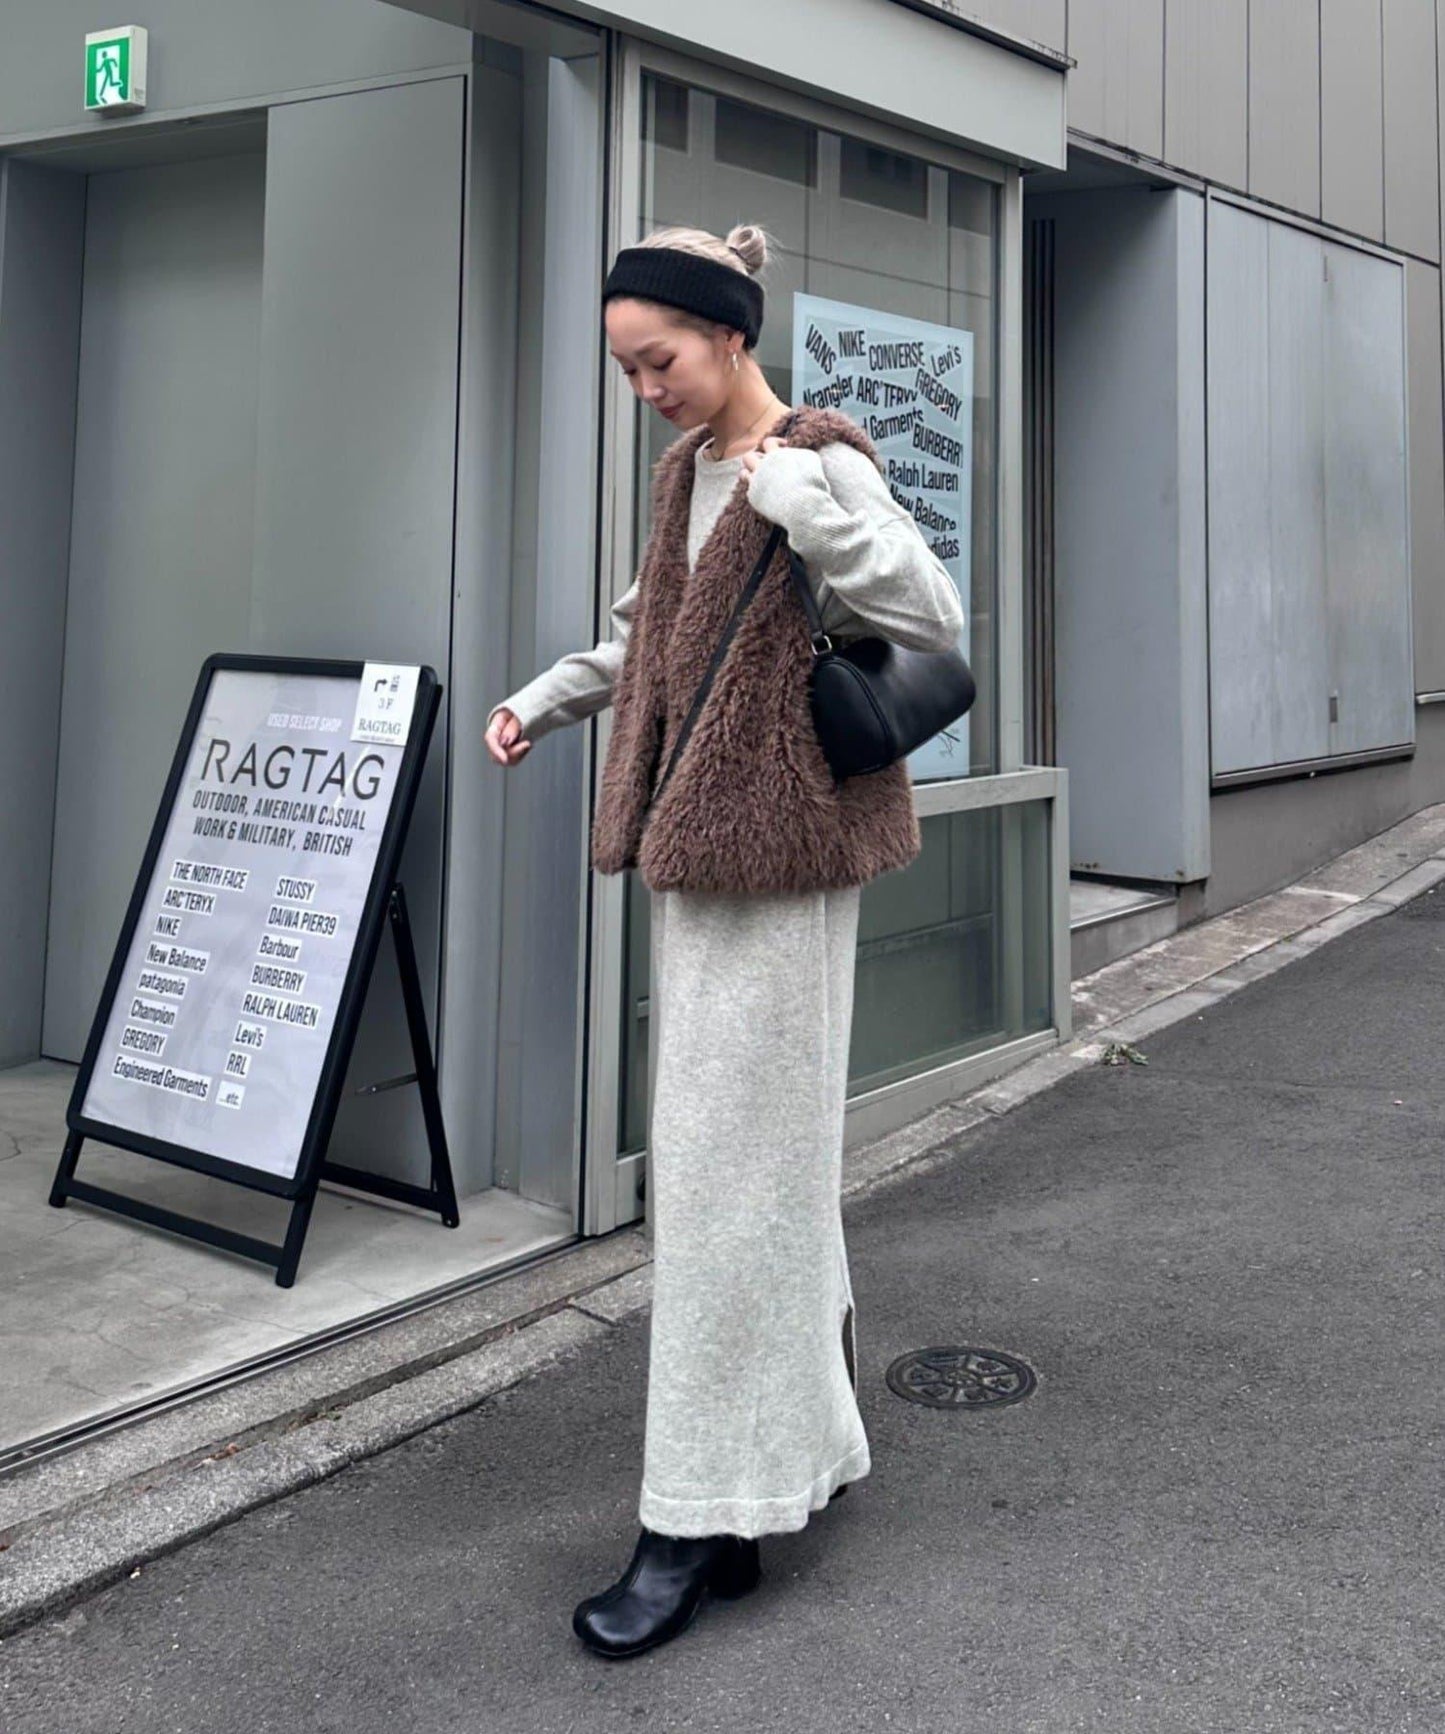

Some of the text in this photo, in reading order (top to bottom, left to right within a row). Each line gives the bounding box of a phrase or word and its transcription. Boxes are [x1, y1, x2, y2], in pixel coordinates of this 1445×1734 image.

[806, 324, 836, 374] VANS
[838, 330, 866, 358] NIKE
[869, 342, 925, 371] CONVERSE
[931, 344, 962, 377] Levi's
[888, 459, 958, 492] Ralph Lauren
[928, 535, 960, 560] didas
[358, 718, 402, 735] RAGTAG
[200, 738, 385, 800] RAGTAG
[193, 790, 366, 830] OUTDOOR, AMERICAN CASUAL
[193, 816, 228, 836] WORK
[303, 832, 353, 856] BRITISH
[174, 862, 248, 890] THE NORTH FACE
[277, 878, 314, 900] STUSSY
[164, 889, 214, 912] ARC'TERYX
[156, 916, 180, 936] NIKE
[268, 906, 336, 936] DAIWA PIER39
[146, 944, 206, 972] New Balance
[260, 936, 299, 959] Barbour
[138, 973, 186, 996] patagonia
[252, 965, 306, 992] BURBERRY
[131, 1000, 175, 1025] Champion
[243, 994, 319, 1027] RALPH LAUREN
[122, 1028, 166, 1054] GREGORY
[235, 1024, 264, 1047] Levi's
[114, 1056, 208, 1098] Engineered Garments
[226, 1053, 248, 1076] RRL
